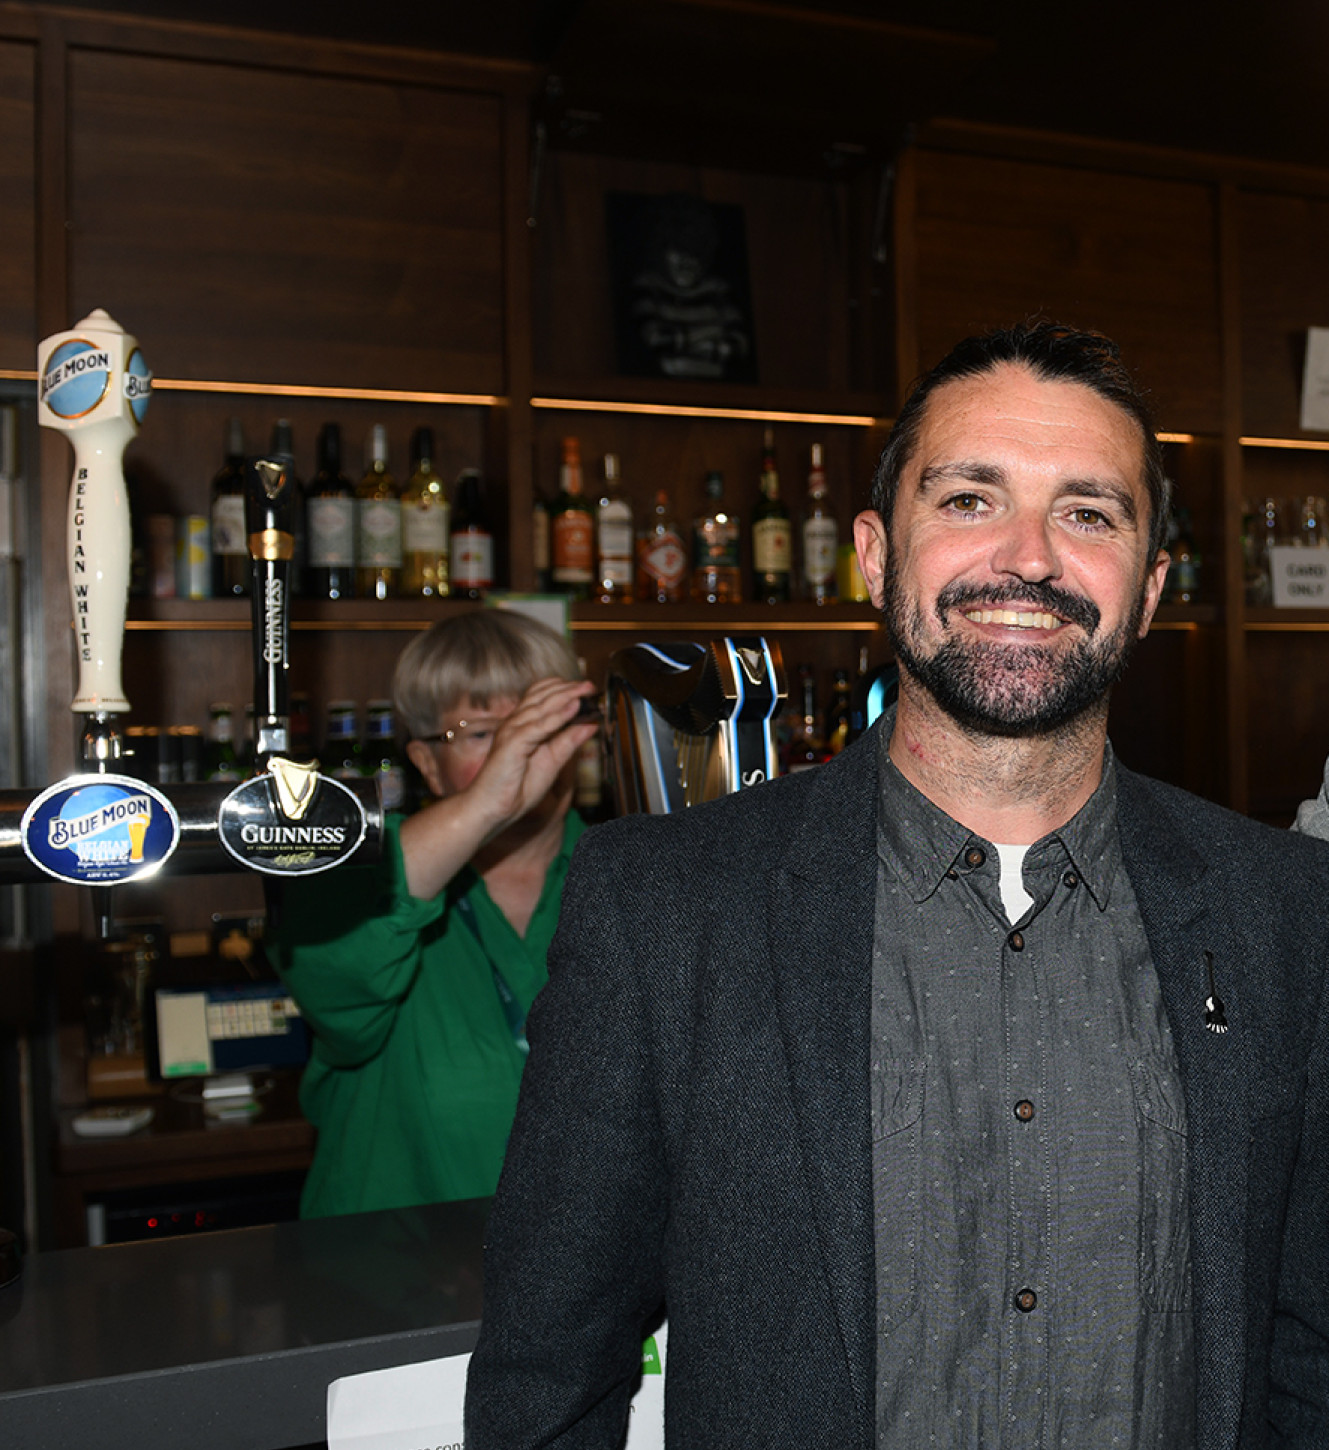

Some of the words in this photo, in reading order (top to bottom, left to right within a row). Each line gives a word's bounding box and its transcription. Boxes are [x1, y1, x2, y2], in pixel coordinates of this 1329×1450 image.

[43, 369, 62, 394] LUE
[64, 353, 109, 378] MOON
[74, 467, 88, 573] BELGIAN
[74, 584, 91, 661] WHITE
[263, 578, 283, 663] GUINNESS
[51, 815, 98, 845] BLUE
[102, 799, 148, 825] MOON
[241, 823, 345, 844] GUINNESS
